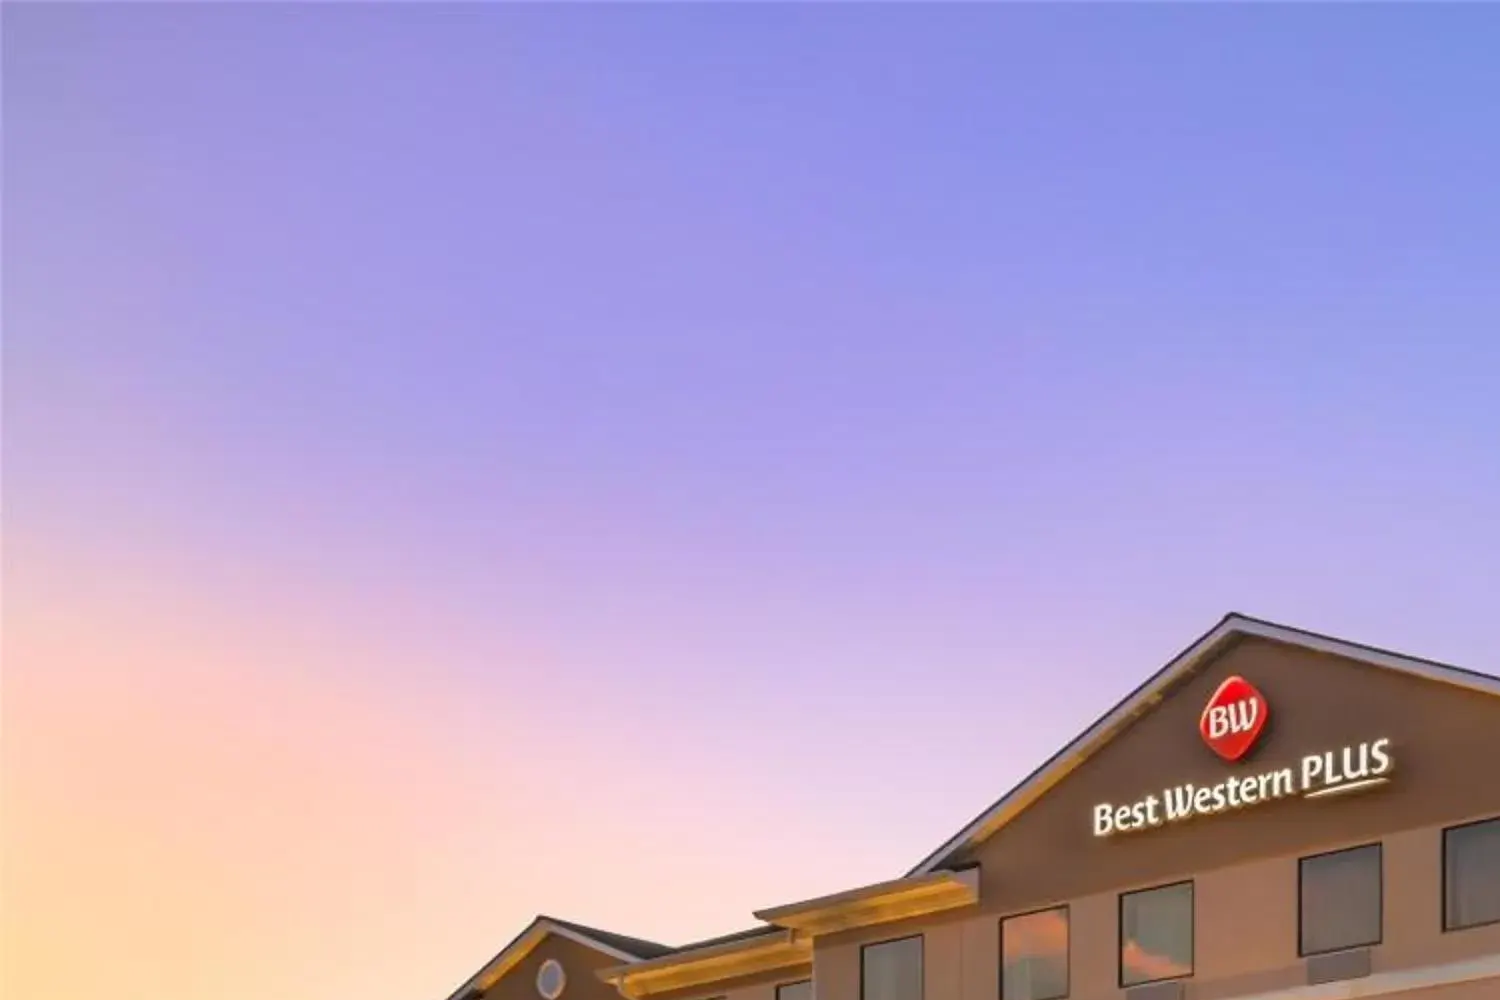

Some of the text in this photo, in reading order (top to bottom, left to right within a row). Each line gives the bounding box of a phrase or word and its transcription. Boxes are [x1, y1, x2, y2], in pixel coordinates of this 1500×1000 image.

[1208, 697, 1258, 739] BW
[1093, 738, 1390, 836] Best Western PLUS
